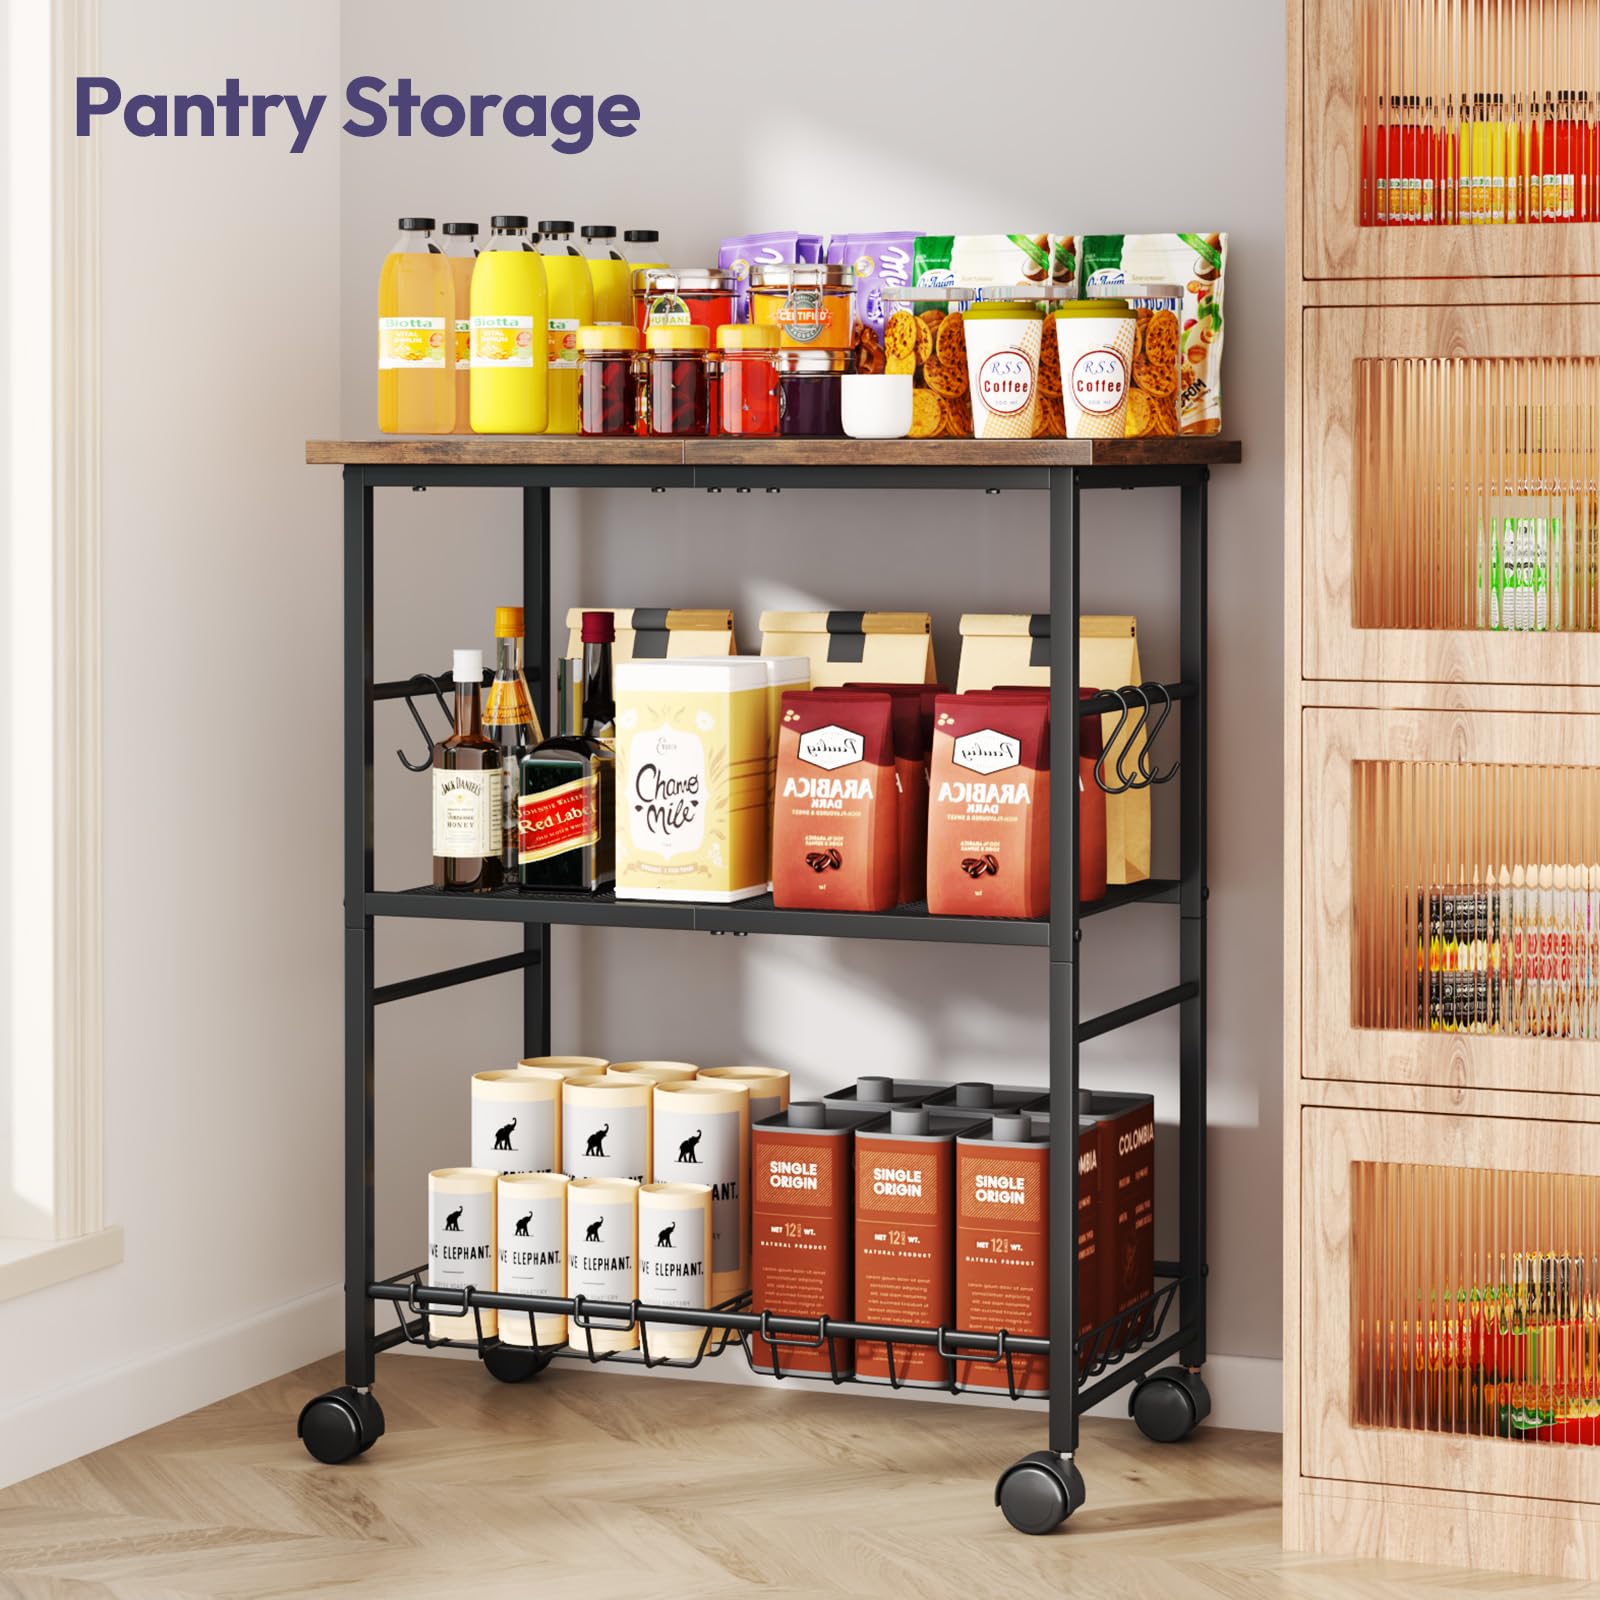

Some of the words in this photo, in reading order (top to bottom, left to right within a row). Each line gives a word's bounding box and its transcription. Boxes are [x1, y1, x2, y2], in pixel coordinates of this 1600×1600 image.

[473, 317, 520, 327] Biotta
[779, 310, 827, 321] CETIFID
[384, 319, 433, 328] Biotta
[984, 380, 1029, 393] Coffee
[1077, 379, 1122, 393] Coffee
[441, 780, 456, 796] JACK
[517, 803, 556, 818] JOHNNIE
[518, 815, 554, 835] Red
[1118, 1122, 1154, 1157] COLOMBIA
[770, 1160, 817, 1176] SINGLE
[1078, 1149, 1097, 1176] MBIA
[770, 1174, 817, 1190] ORIGIN
[873, 1168, 922, 1183] SINGLE
[975, 1174, 1025, 1190] SINGLE
[873, 1182, 922, 1197] ORIGIN
[975, 1189, 1025, 1205] ORIGIN
[785, 1222, 797, 1237] 12
[888, 1230, 900, 1245] 12
[443, 1244, 492, 1260] ELEPHANT.
[991, 1238, 1003, 1253] 12
[513, 1250, 561, 1266] ELEPHANT.
[583, 1256, 632, 1271] ELEPHANT.
[655, 1261, 704, 1277] ELEPHANT.
